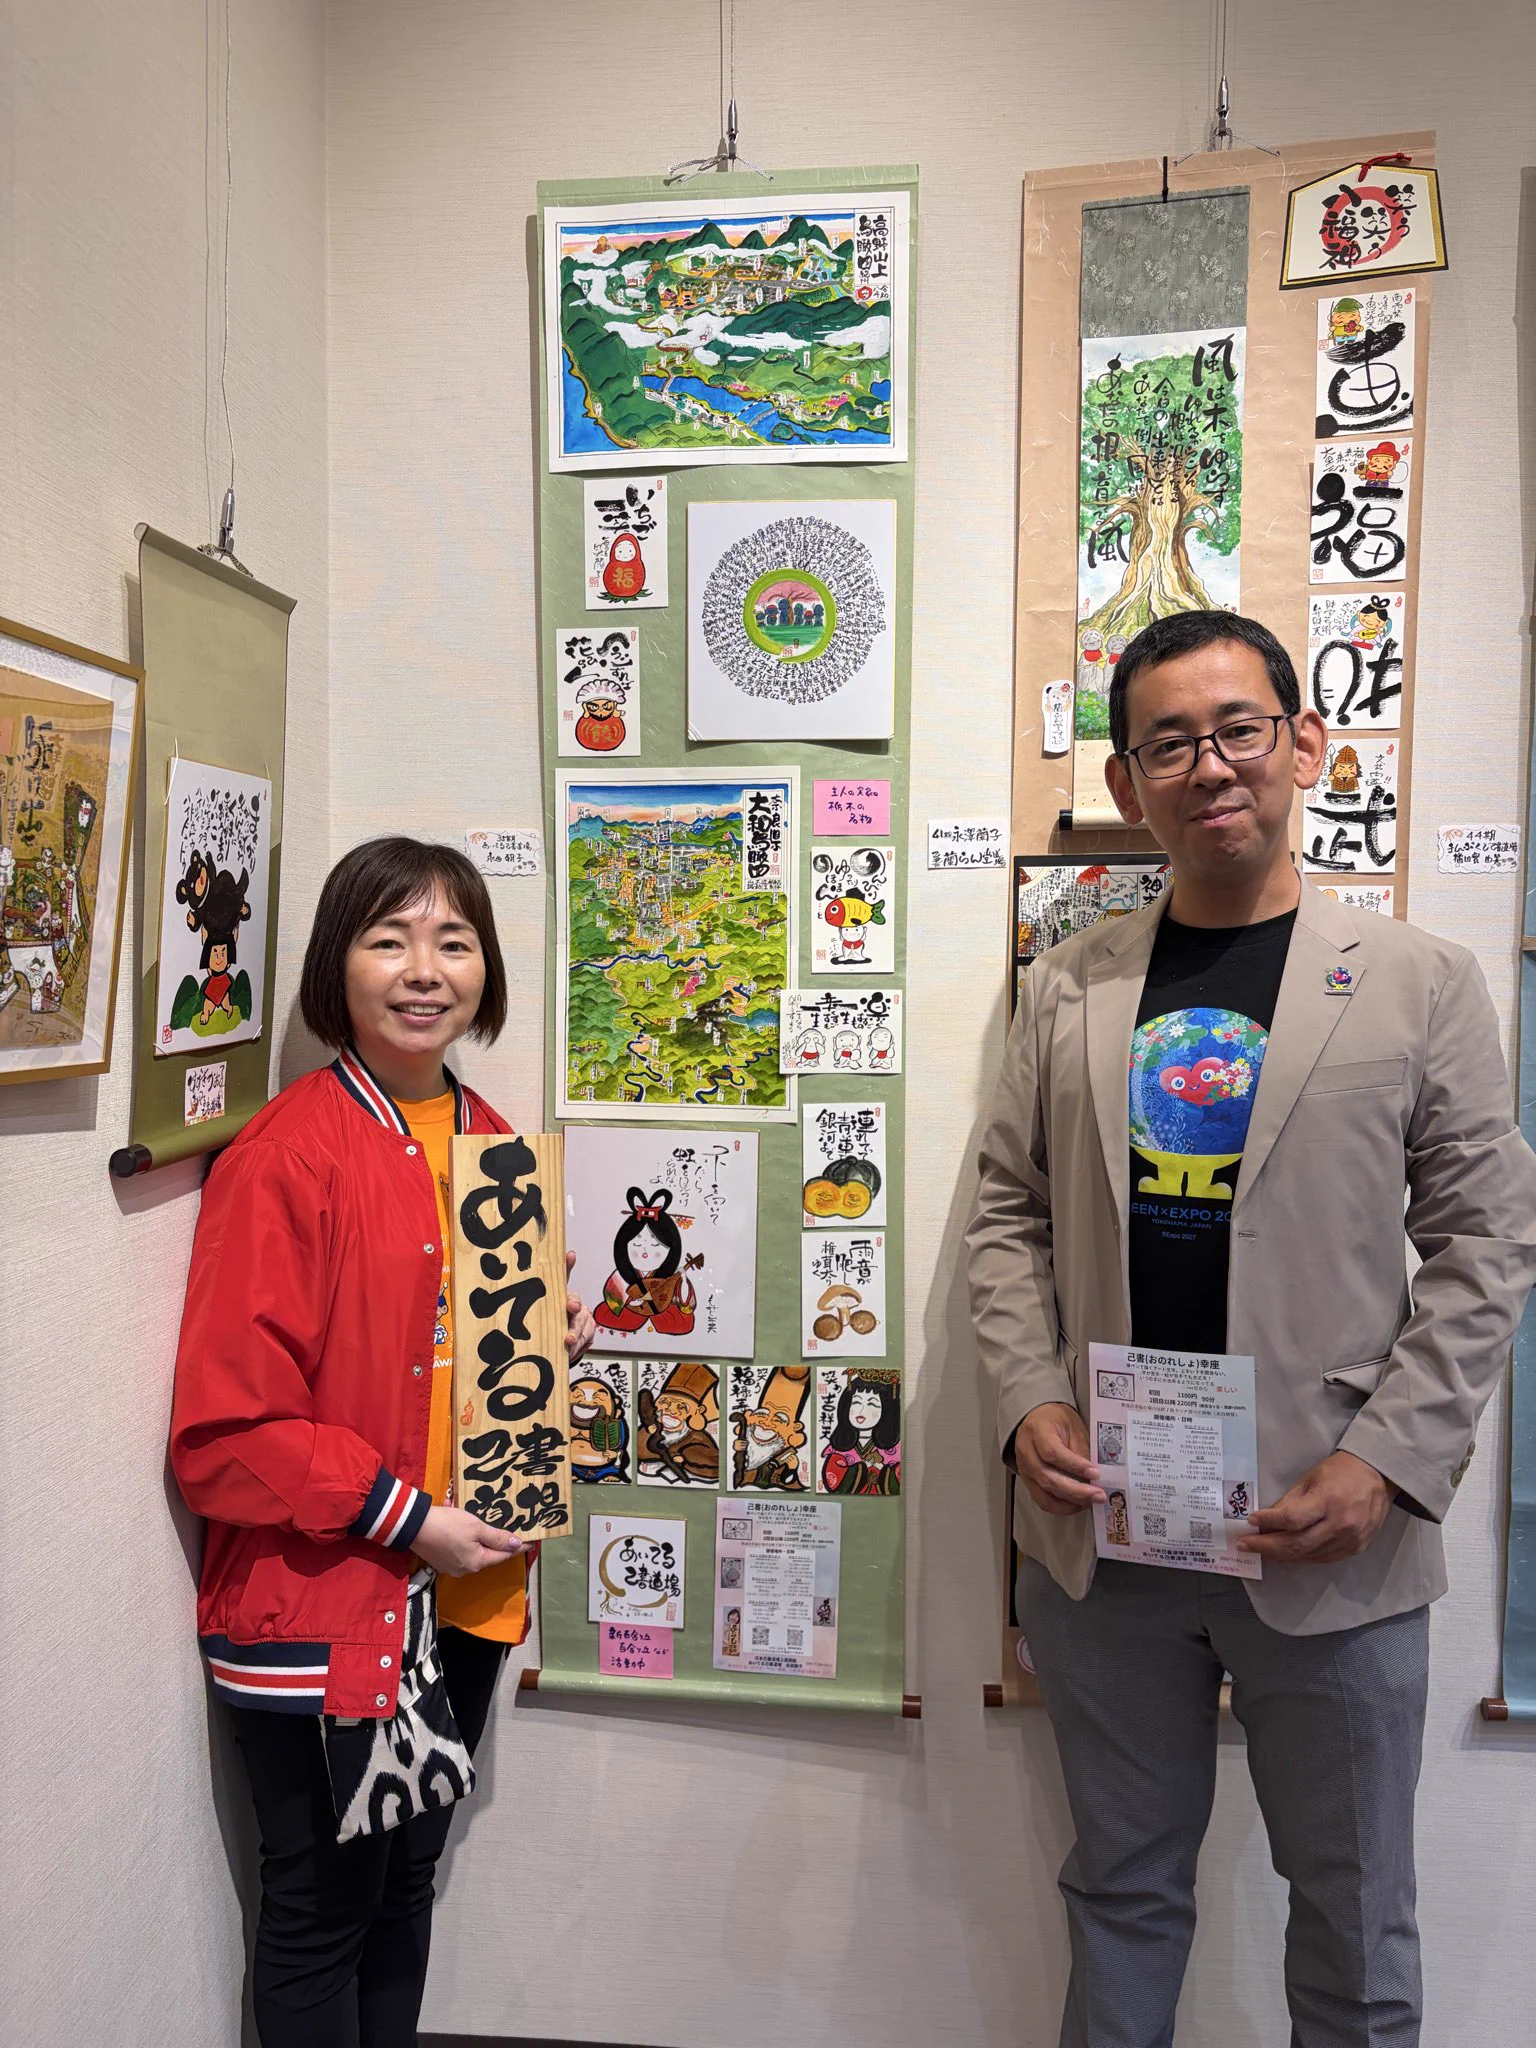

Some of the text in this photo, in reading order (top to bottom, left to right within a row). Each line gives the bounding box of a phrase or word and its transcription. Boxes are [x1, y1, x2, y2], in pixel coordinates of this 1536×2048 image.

[1360, 206, 1391, 260] 笑う
[1384, 184, 1417, 238] 笑う
[870, 214, 889, 279] 高野山上
[1310, 472, 1406, 579] 福
[815, 1108, 838, 1161] 銀河まで
[1151, 1217, 1188, 1228] YOKOHAMA
[459, 1136, 556, 1422] あいてる
[849, 1239, 879, 1285] 雨音が
[1127, 1352, 1220, 1370] 己書(おのれしょ)幸座
[462, 1422, 569, 1483] 己書
[747, 1502, 817, 1514] 己書(おのれしょ)幸座
[619, 1536, 676, 1570] あいてる
[623, 1563, 682, 1599] 己書道場
